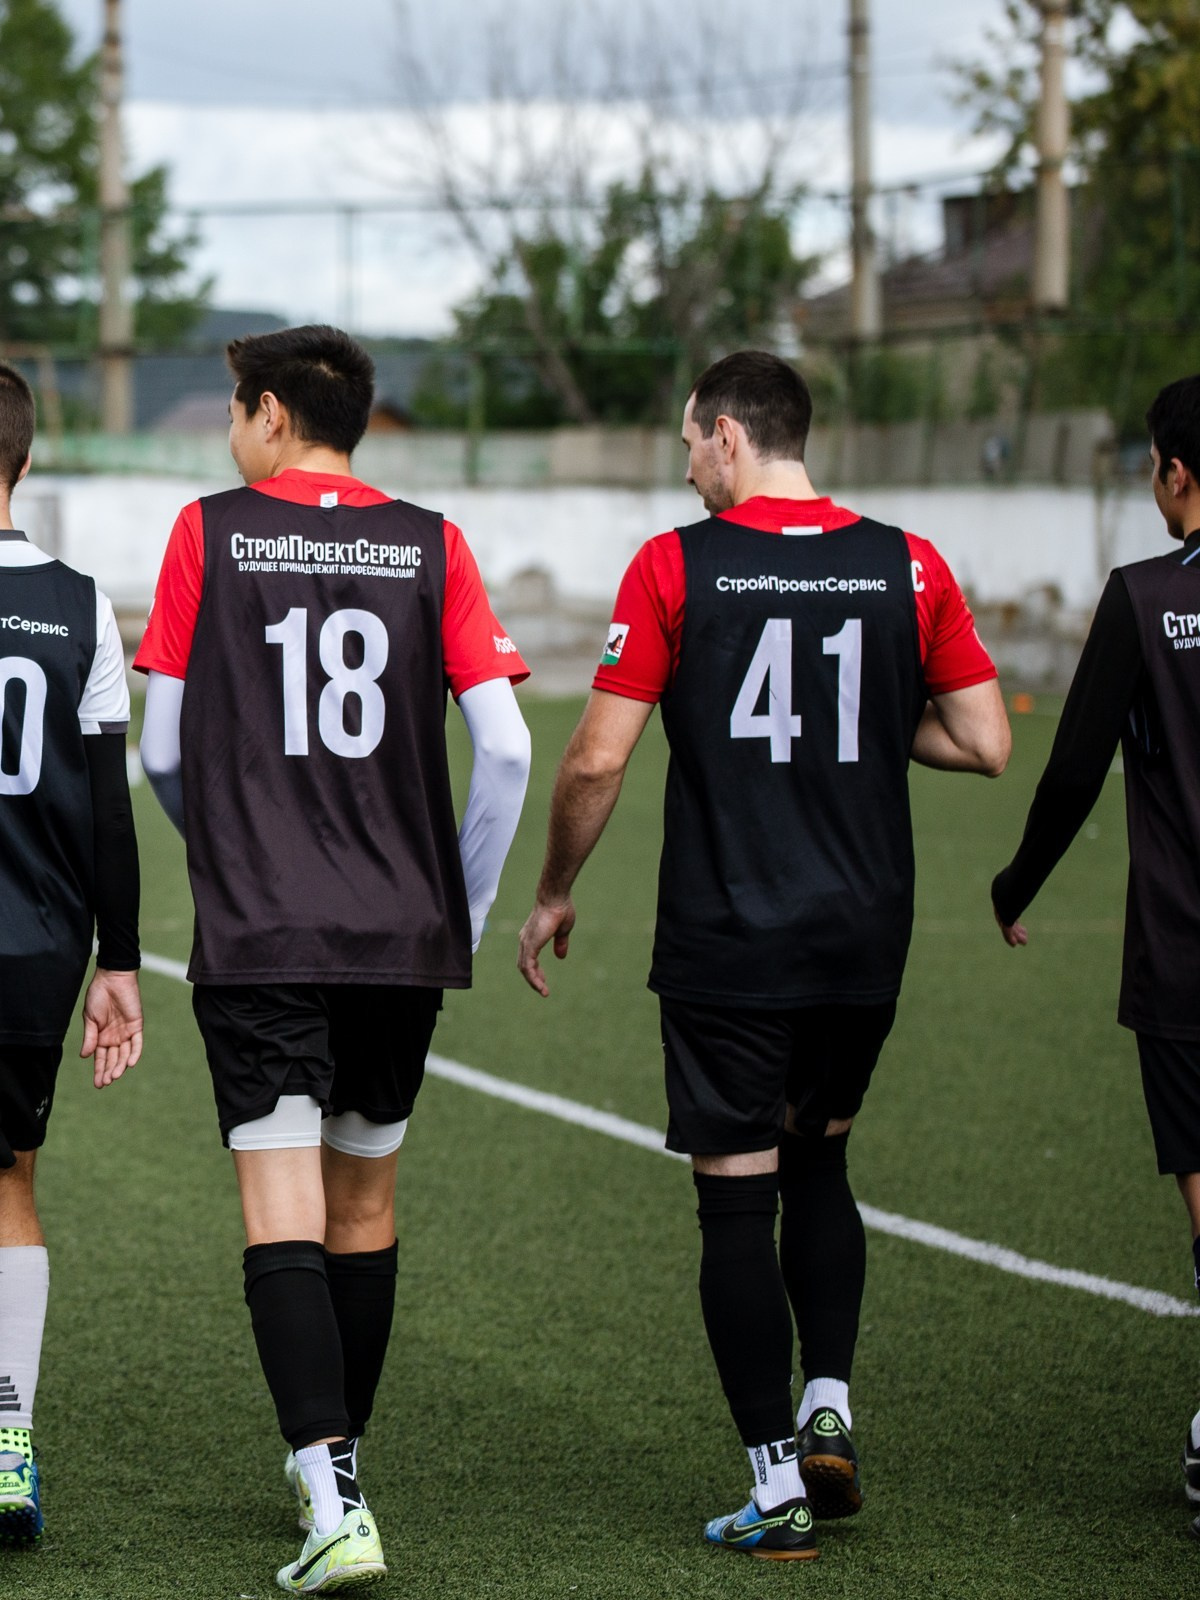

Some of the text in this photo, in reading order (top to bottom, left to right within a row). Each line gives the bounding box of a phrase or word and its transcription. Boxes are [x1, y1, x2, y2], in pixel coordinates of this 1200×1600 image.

[238, 561, 416, 579] БУДУЩЕЕ ПРИНАДЛЕЖИТ ПРОФЕССИОНАЛАМ!
[716, 575, 887, 594] СтройПроектСервис
[265, 607, 389, 759] 18
[730, 618, 862, 763] 41
